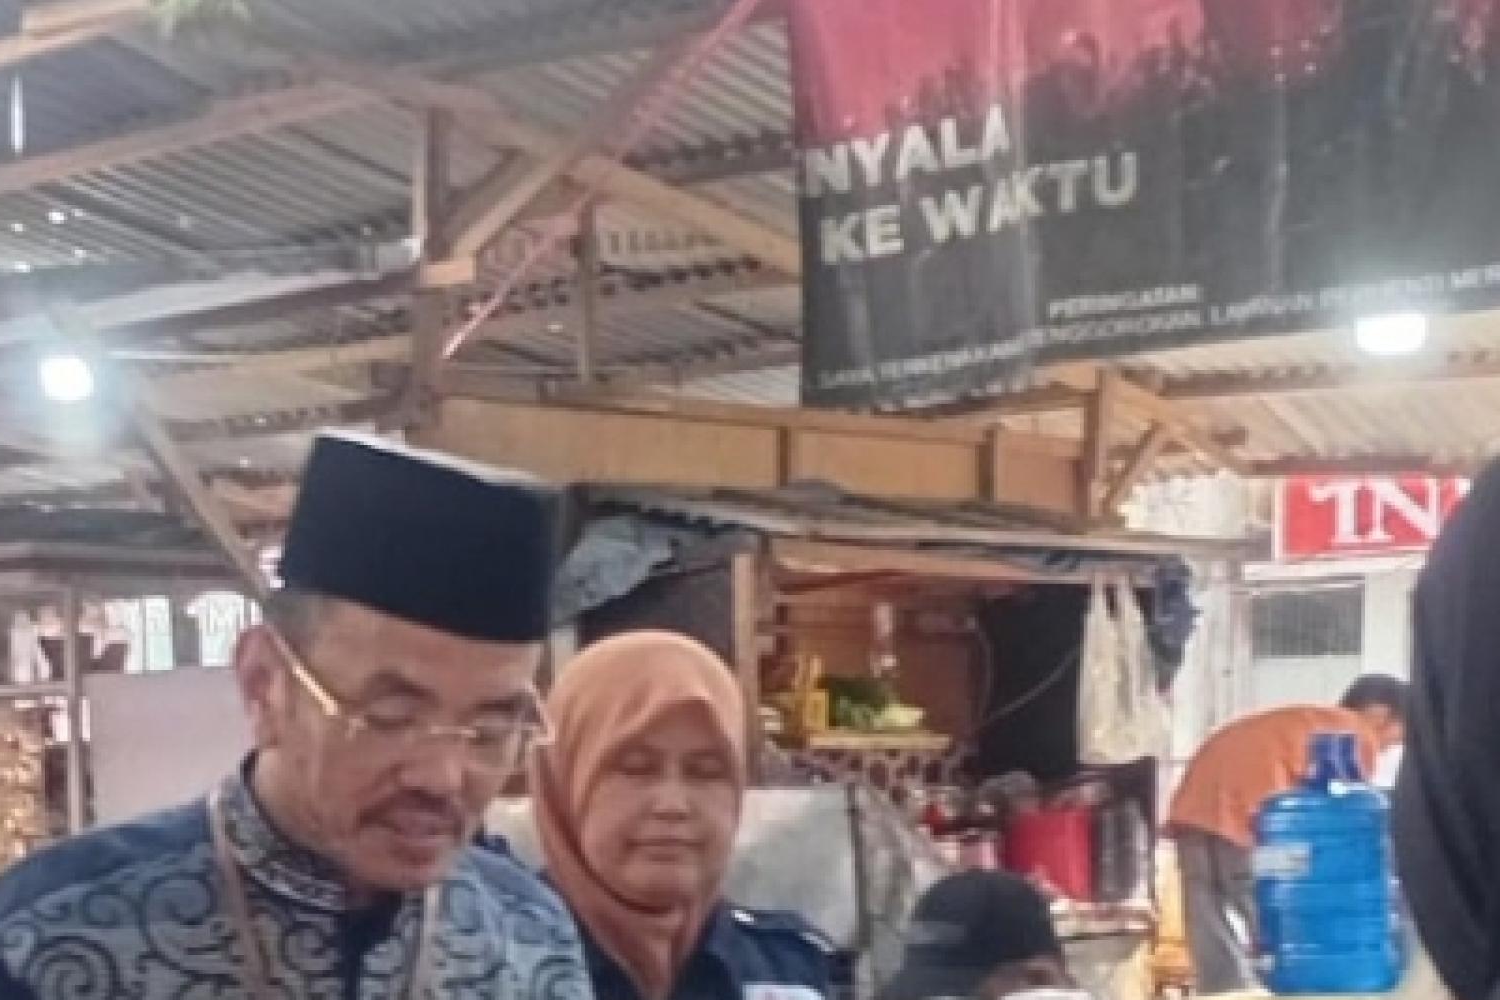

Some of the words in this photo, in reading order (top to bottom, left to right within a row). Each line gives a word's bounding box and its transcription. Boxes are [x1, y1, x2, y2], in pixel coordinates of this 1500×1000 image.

[804, 103, 1011, 198] NYALA
[820, 204, 905, 266] KE
[919, 151, 1139, 243] WAKTU
